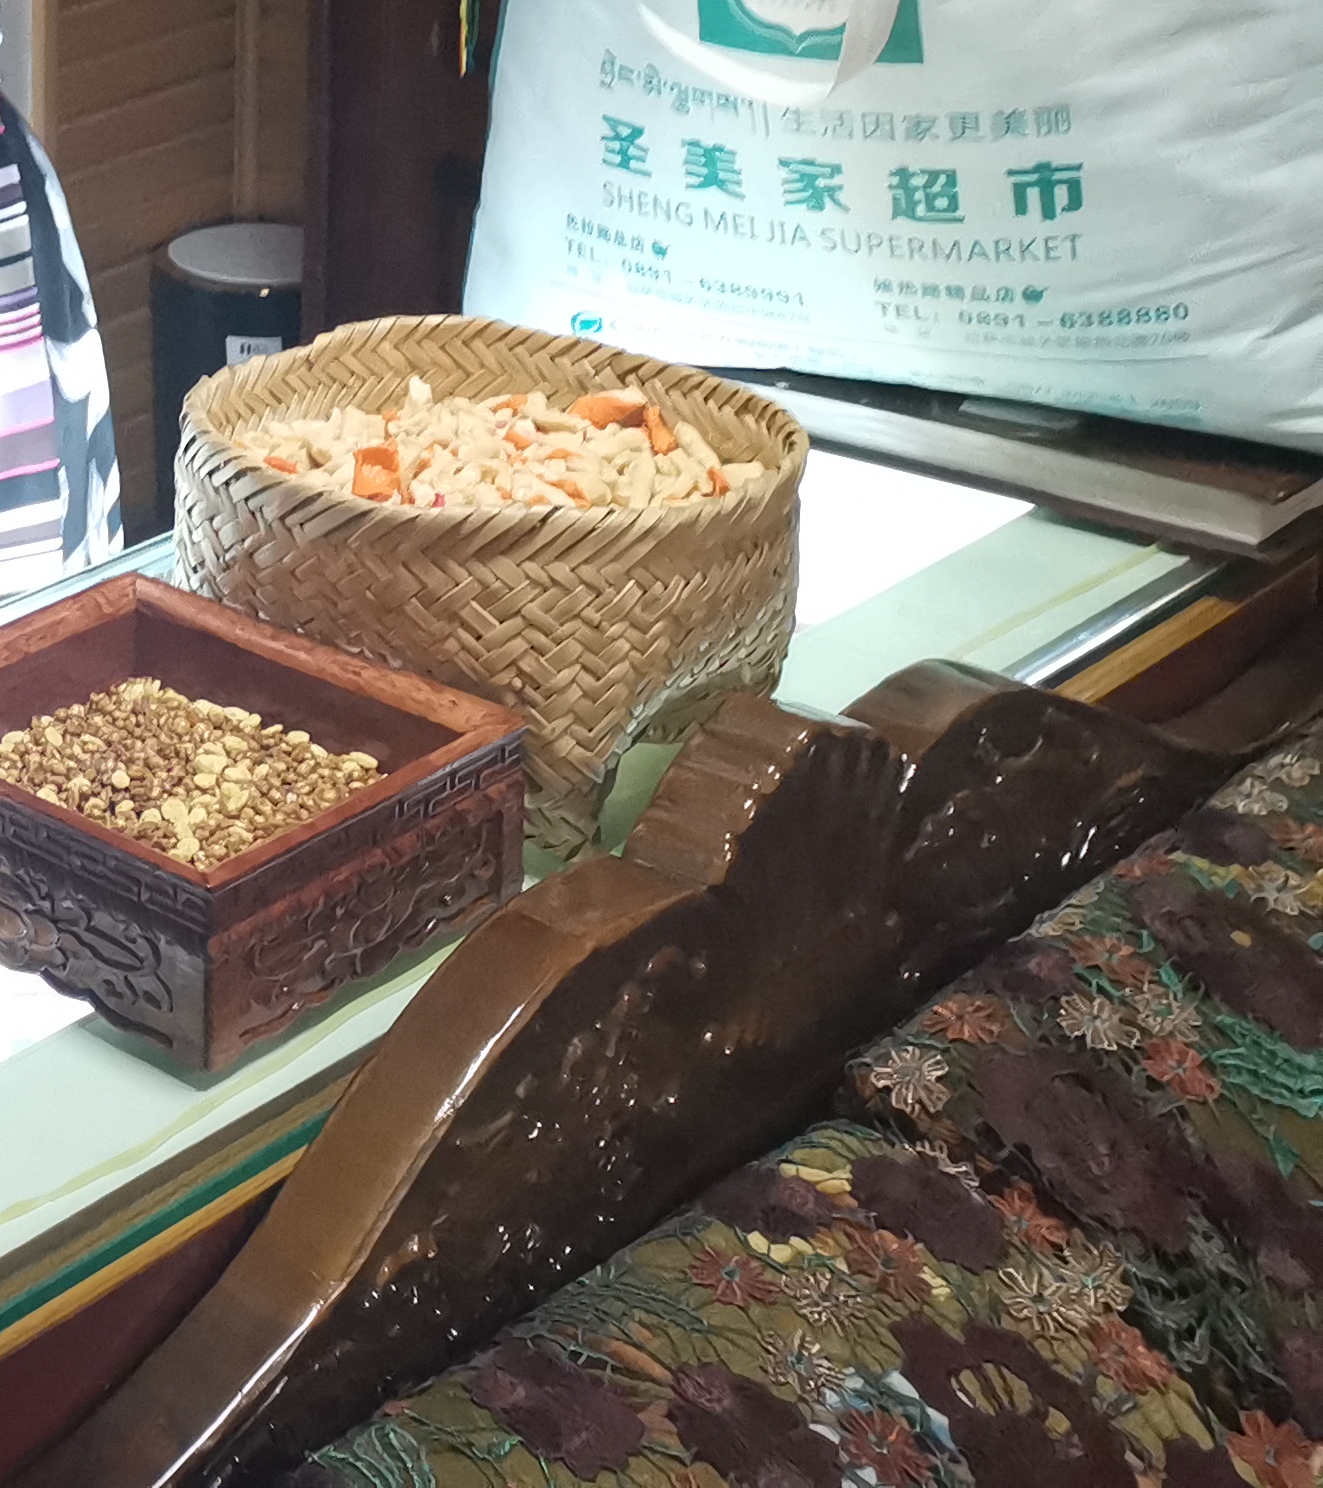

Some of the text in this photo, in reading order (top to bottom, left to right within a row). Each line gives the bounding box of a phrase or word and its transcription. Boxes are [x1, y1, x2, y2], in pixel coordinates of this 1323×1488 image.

[599, 113, 1084, 224] 圣美家超市
[602, 180, 695, 229] SHENG
[820, 225, 1084, 265] SUPERMARKET
